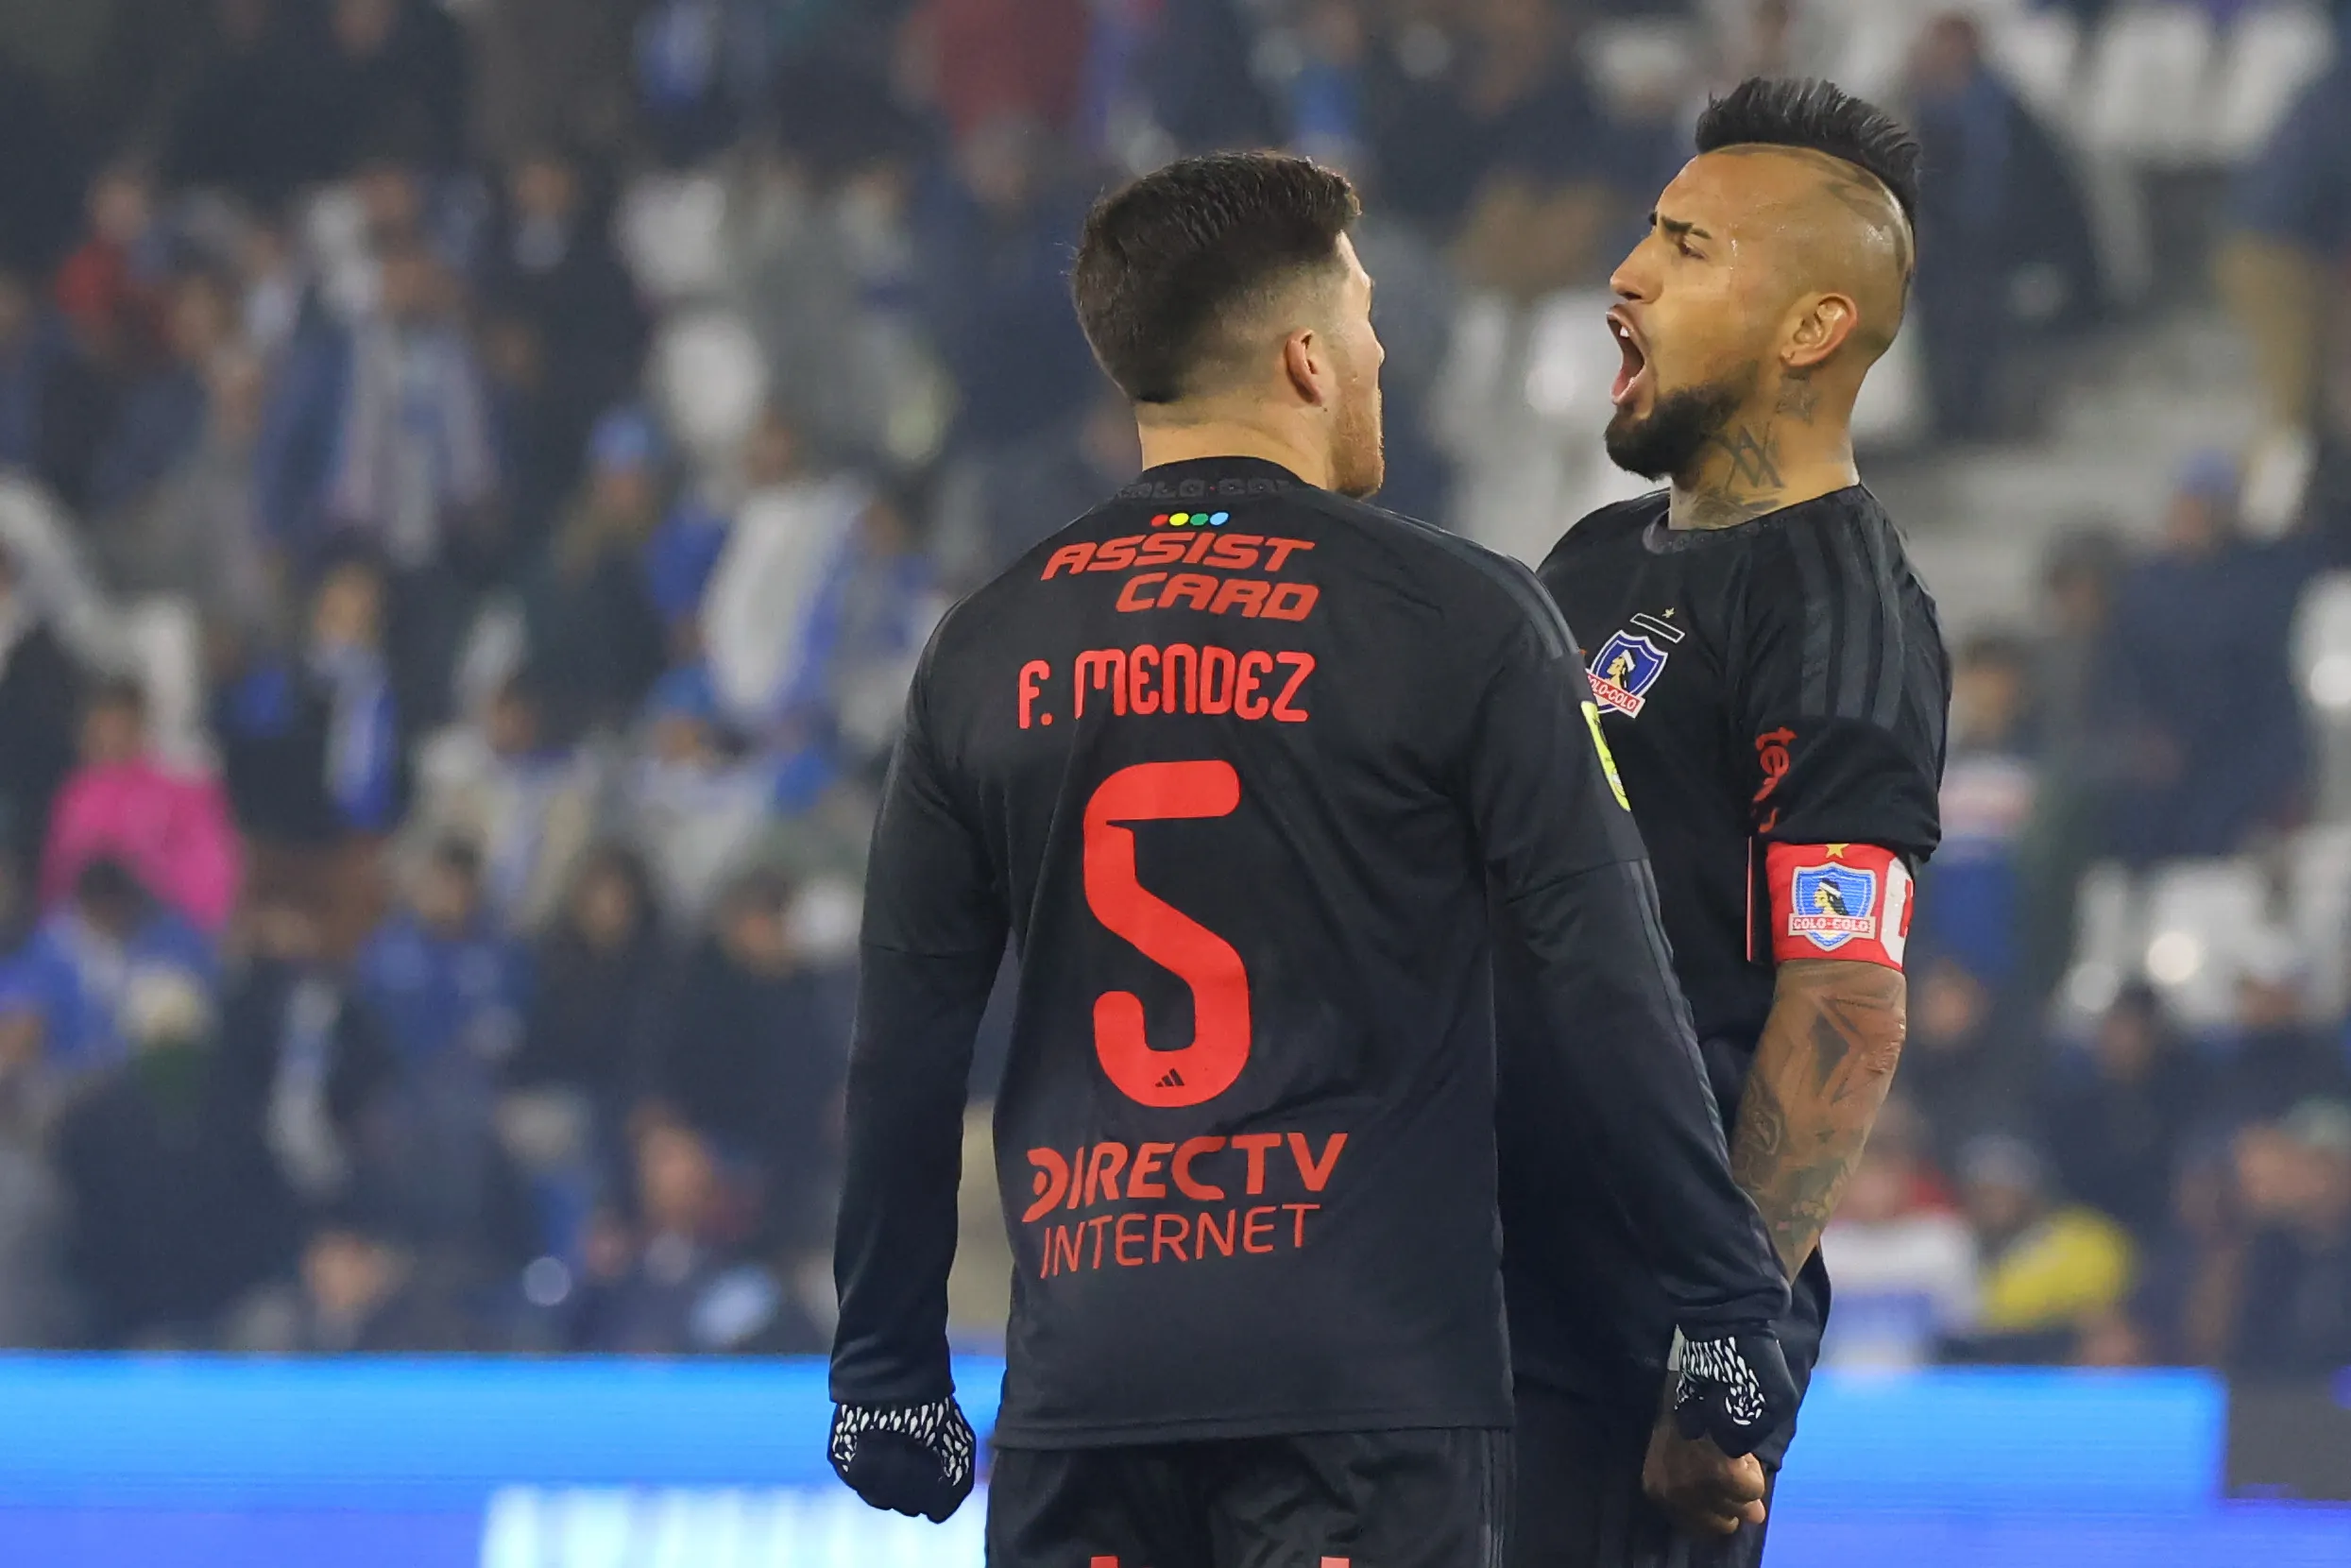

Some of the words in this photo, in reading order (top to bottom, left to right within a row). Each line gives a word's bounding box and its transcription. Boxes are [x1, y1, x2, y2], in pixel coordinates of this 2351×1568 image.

[1041, 531, 1316, 581] ASSIST
[1115, 571, 1320, 622] CARD
[1017, 659, 1054, 730] F.
[1073, 642, 1318, 724] MENDEZ
[1588, 674, 1638, 710] OLO-COLO
[1082, 759, 1252, 1109] 5
[1794, 916, 1869, 933] COLO-COLO
[1022, 1132, 1349, 1223] DIRECTV
[1040, 1202, 1321, 1279] INTERNET
